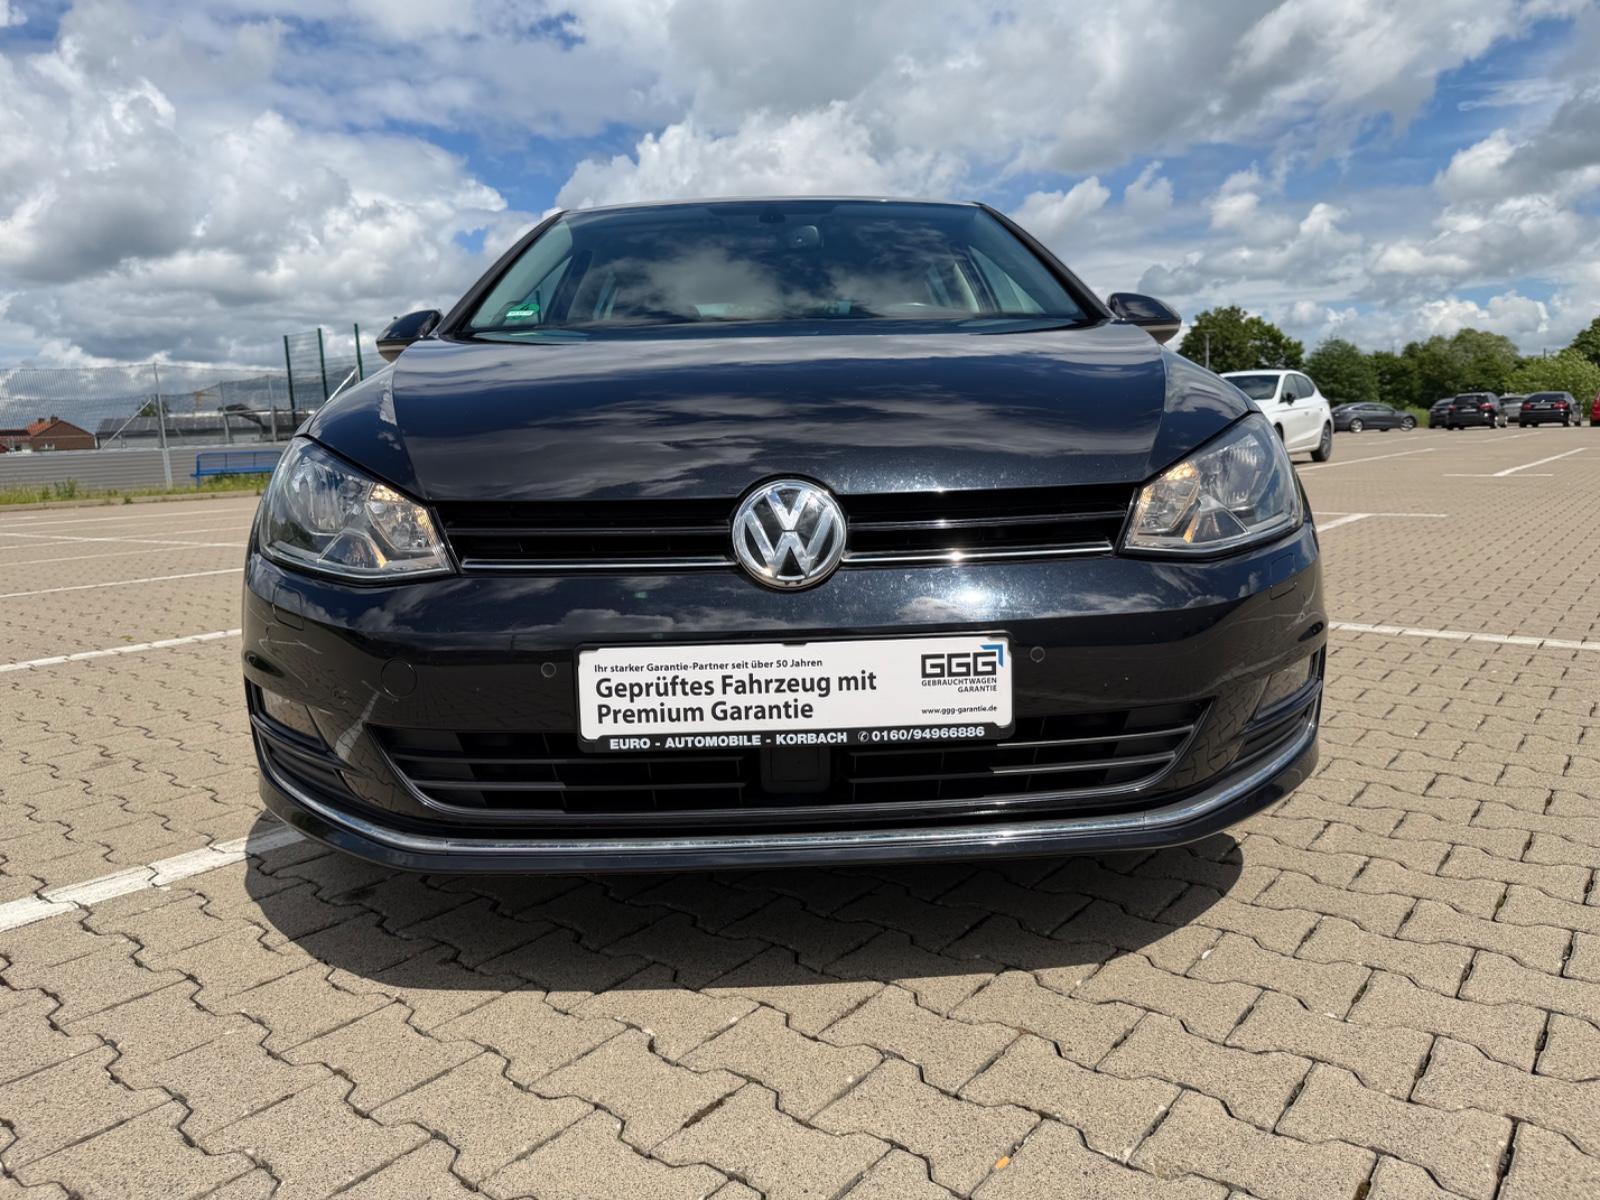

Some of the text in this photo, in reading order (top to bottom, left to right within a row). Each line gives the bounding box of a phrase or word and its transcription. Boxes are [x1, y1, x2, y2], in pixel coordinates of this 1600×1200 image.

[594, 658, 823, 673] Ihr starker Garantie-Partner seit über 50 Jahren
[921, 652, 997, 678] GGG
[595, 669, 877, 703] Geprüftes Fahrzeug mit
[921, 677, 997, 687] GEBRAUCHTWAGEN
[957, 685, 998, 693] GARANTIE
[597, 698, 814, 724] Premium Garantie
[921, 705, 998, 715] www.ggg-garantie.de
[609, 738, 651, 750] EURO
[665, 734, 762, 749] AUTOMOBILE
[775, 731, 848, 745] KORBACH
[871, 726, 985, 741] 0160/94966886
